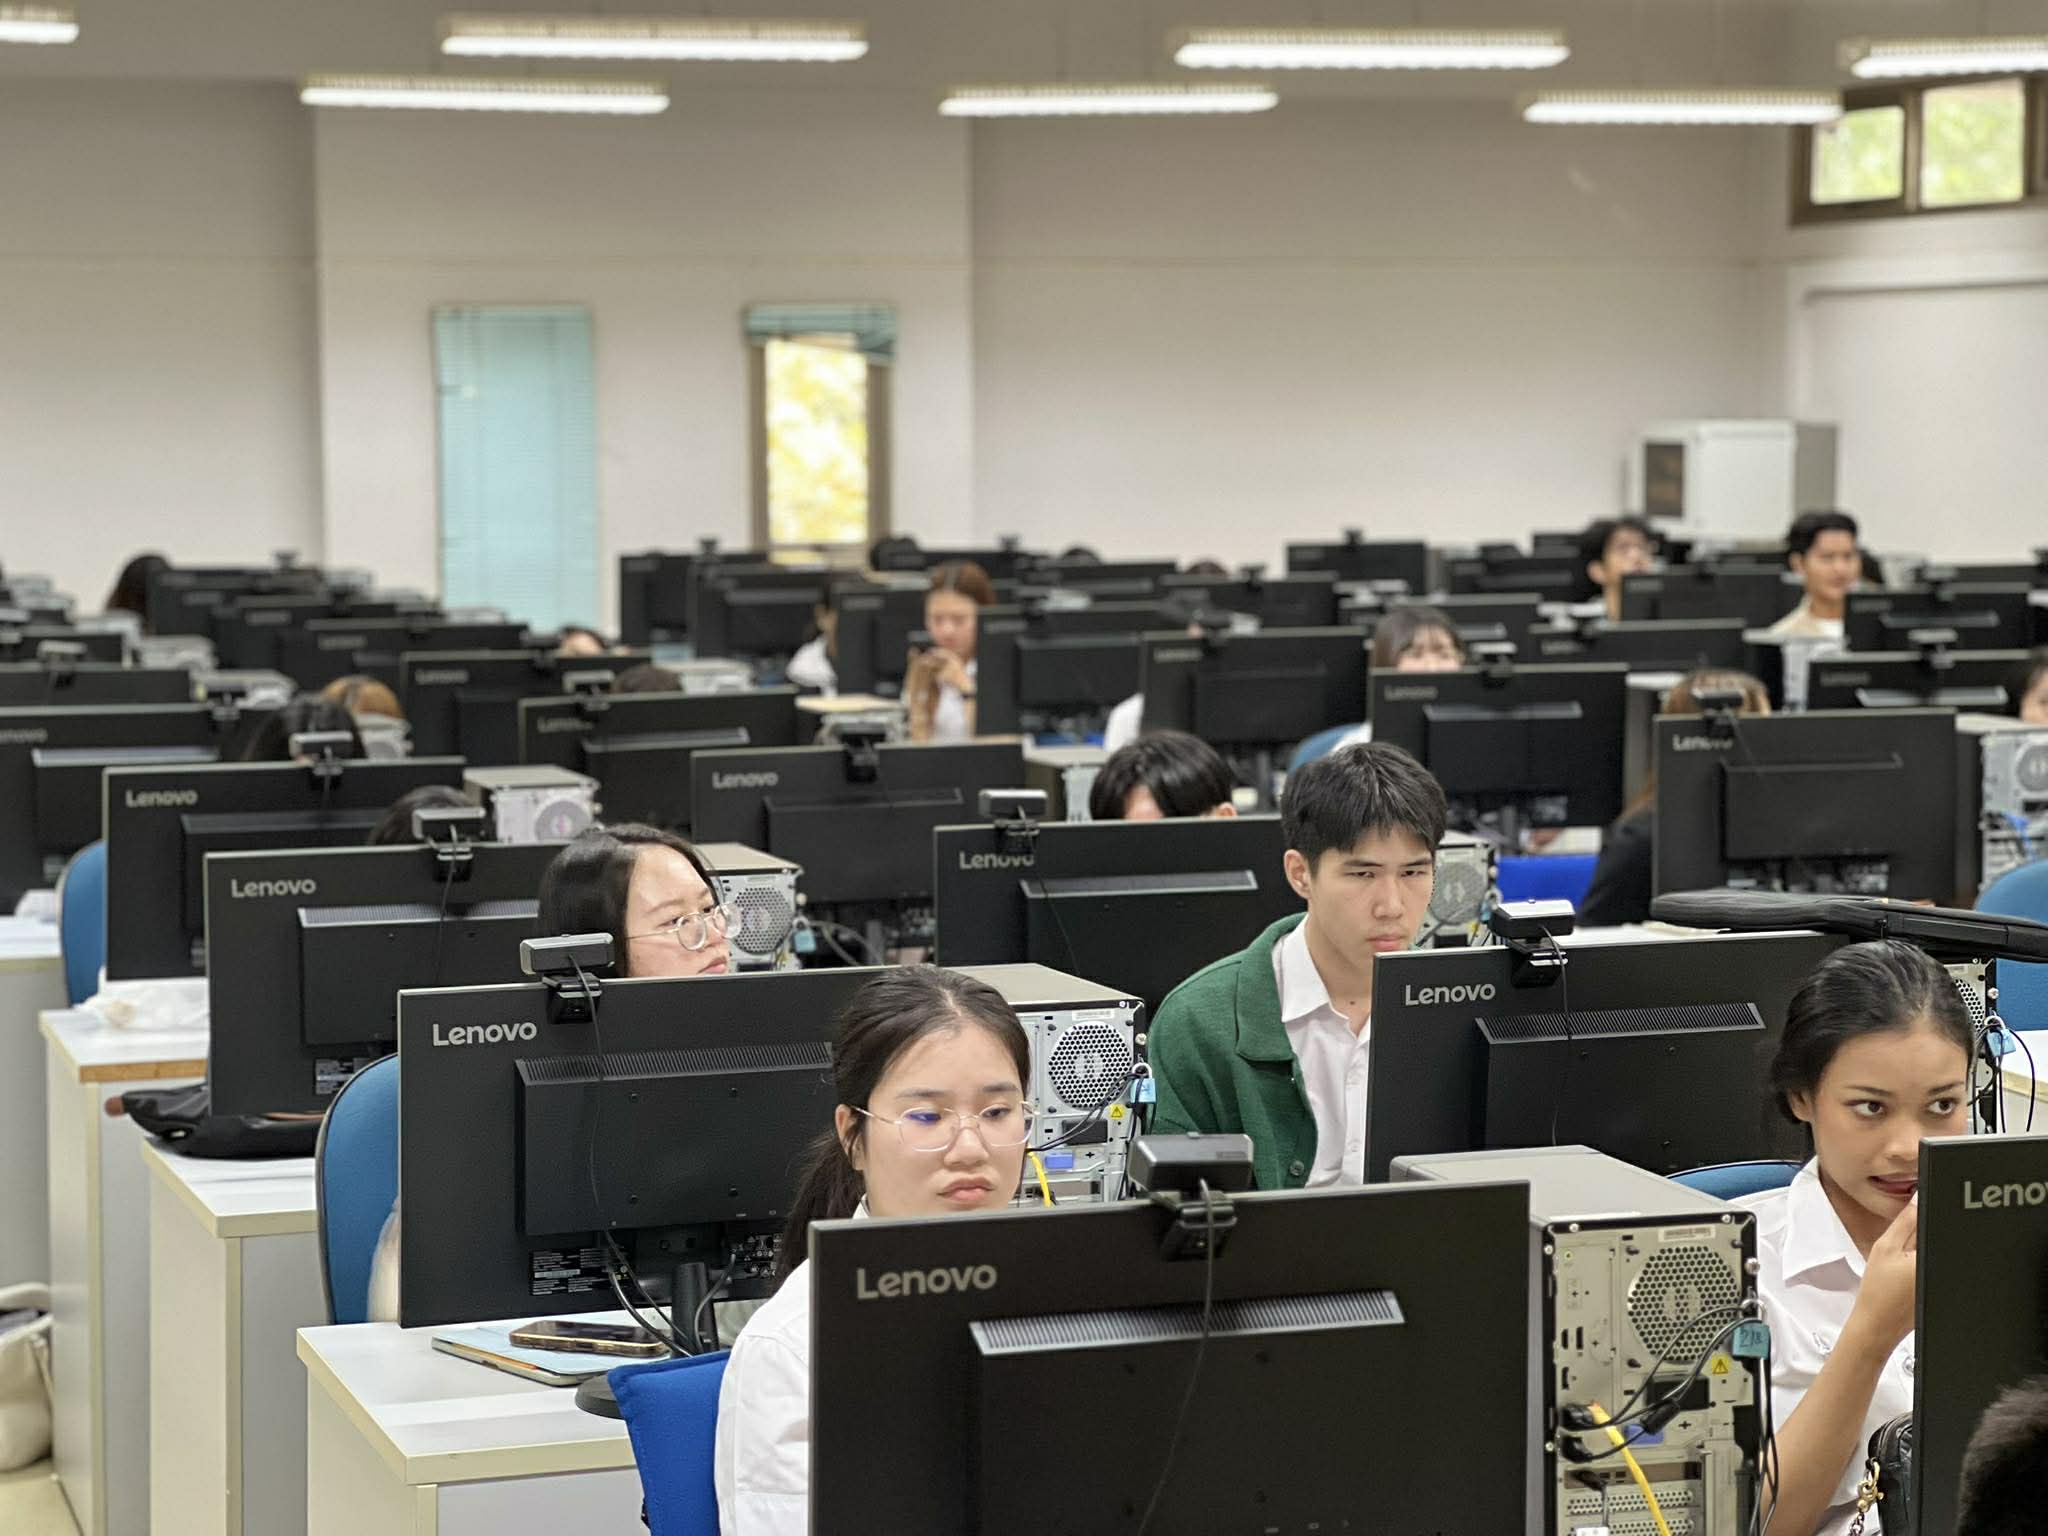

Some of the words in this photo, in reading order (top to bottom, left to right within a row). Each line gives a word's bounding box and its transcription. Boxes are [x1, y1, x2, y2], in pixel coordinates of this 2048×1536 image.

[712, 771, 779, 789] Lenovo
[126, 789, 198, 808] Lenovo
[959, 850, 1035, 870] Lenovo
[231, 878, 317, 899] Lenovo
[1405, 983, 1496, 1006] Lenovo
[432, 1022, 537, 1047] Lenovo
[1963, 1180, 2048, 1209] Leno
[856, 1264, 998, 1300] Lenovo
